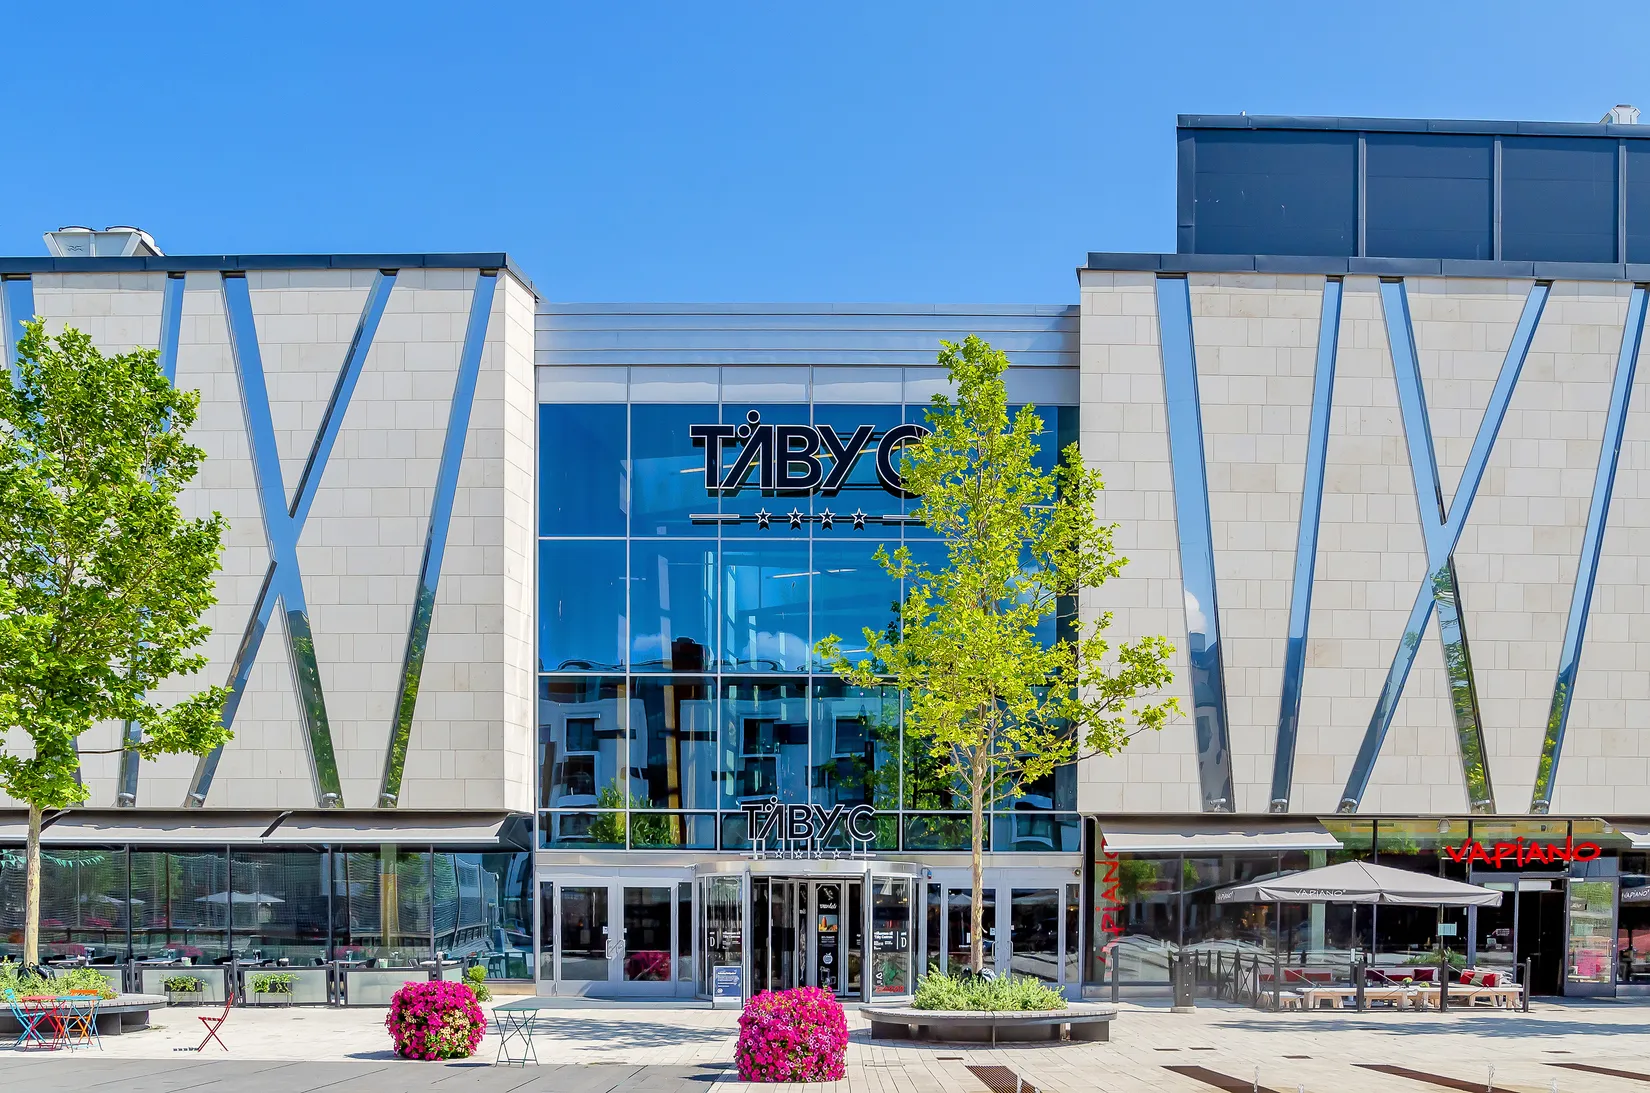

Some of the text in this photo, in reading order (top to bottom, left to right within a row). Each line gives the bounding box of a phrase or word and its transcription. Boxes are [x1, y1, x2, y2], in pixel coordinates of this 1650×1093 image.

[689, 410, 933, 491] TÄBY C
[741, 796, 877, 841] TÄBY C
[1445, 836, 1602, 869] VAPIANO
